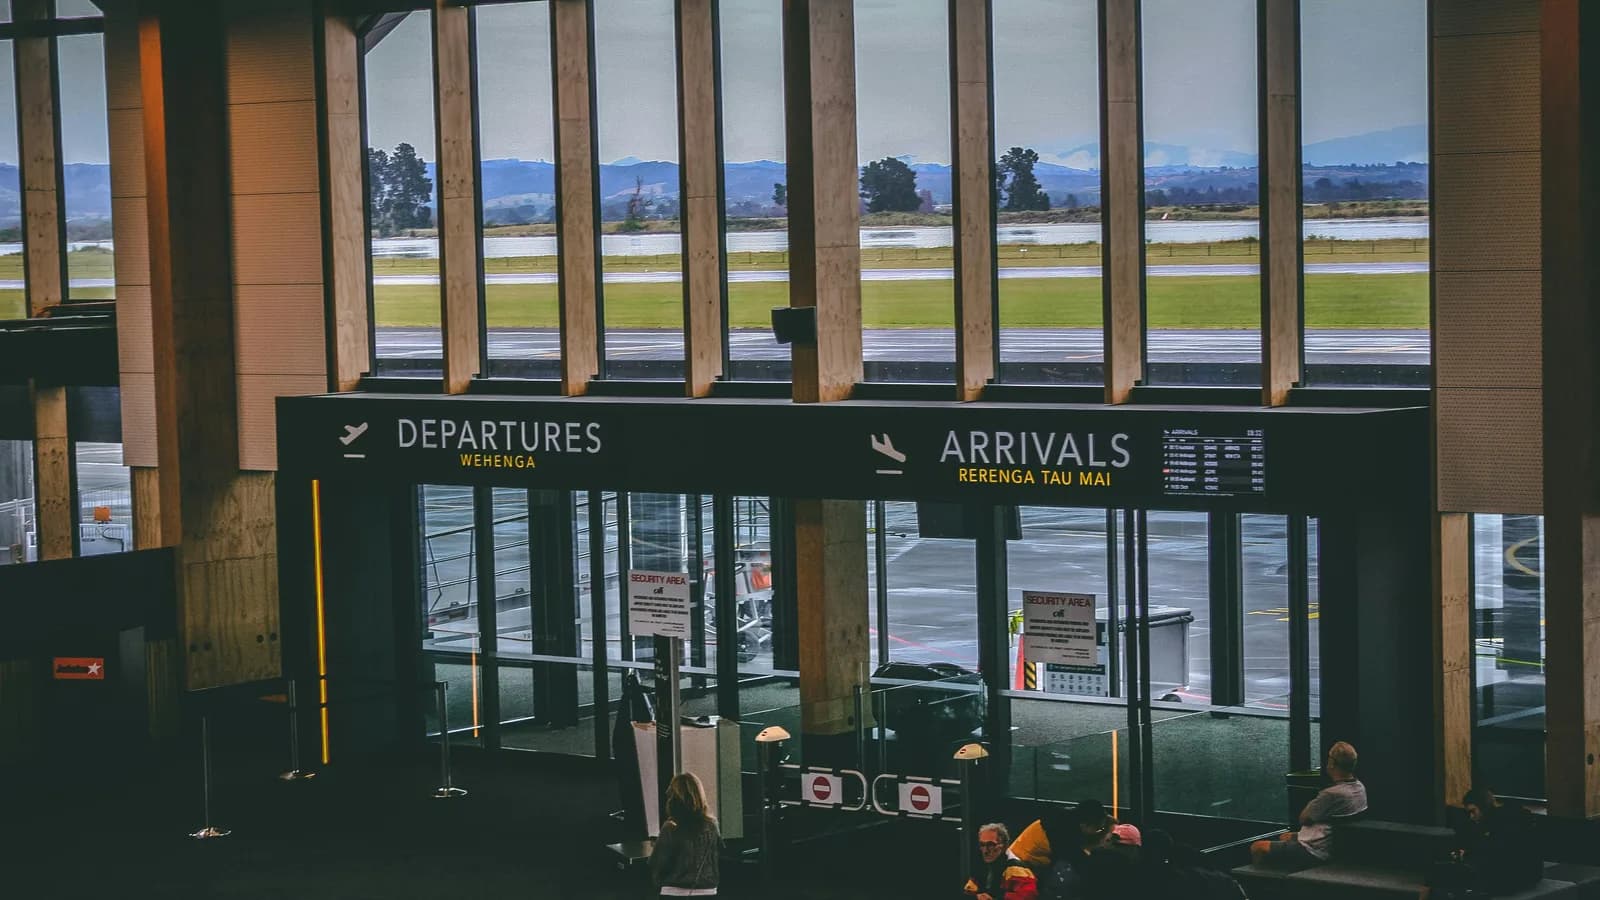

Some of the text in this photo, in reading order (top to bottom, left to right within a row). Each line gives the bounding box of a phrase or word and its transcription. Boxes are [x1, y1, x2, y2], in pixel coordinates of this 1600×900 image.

[398, 418, 602, 454] DEPARTURES
[939, 430, 1131, 468] ARRIVALS
[460, 453, 536, 469] WEHENGA
[959, 468, 1111, 487] RERENGA TAU MAI
[631, 574, 687, 585] SECURITY AREA
[1025, 595, 1092, 607] SECURITY AREA
